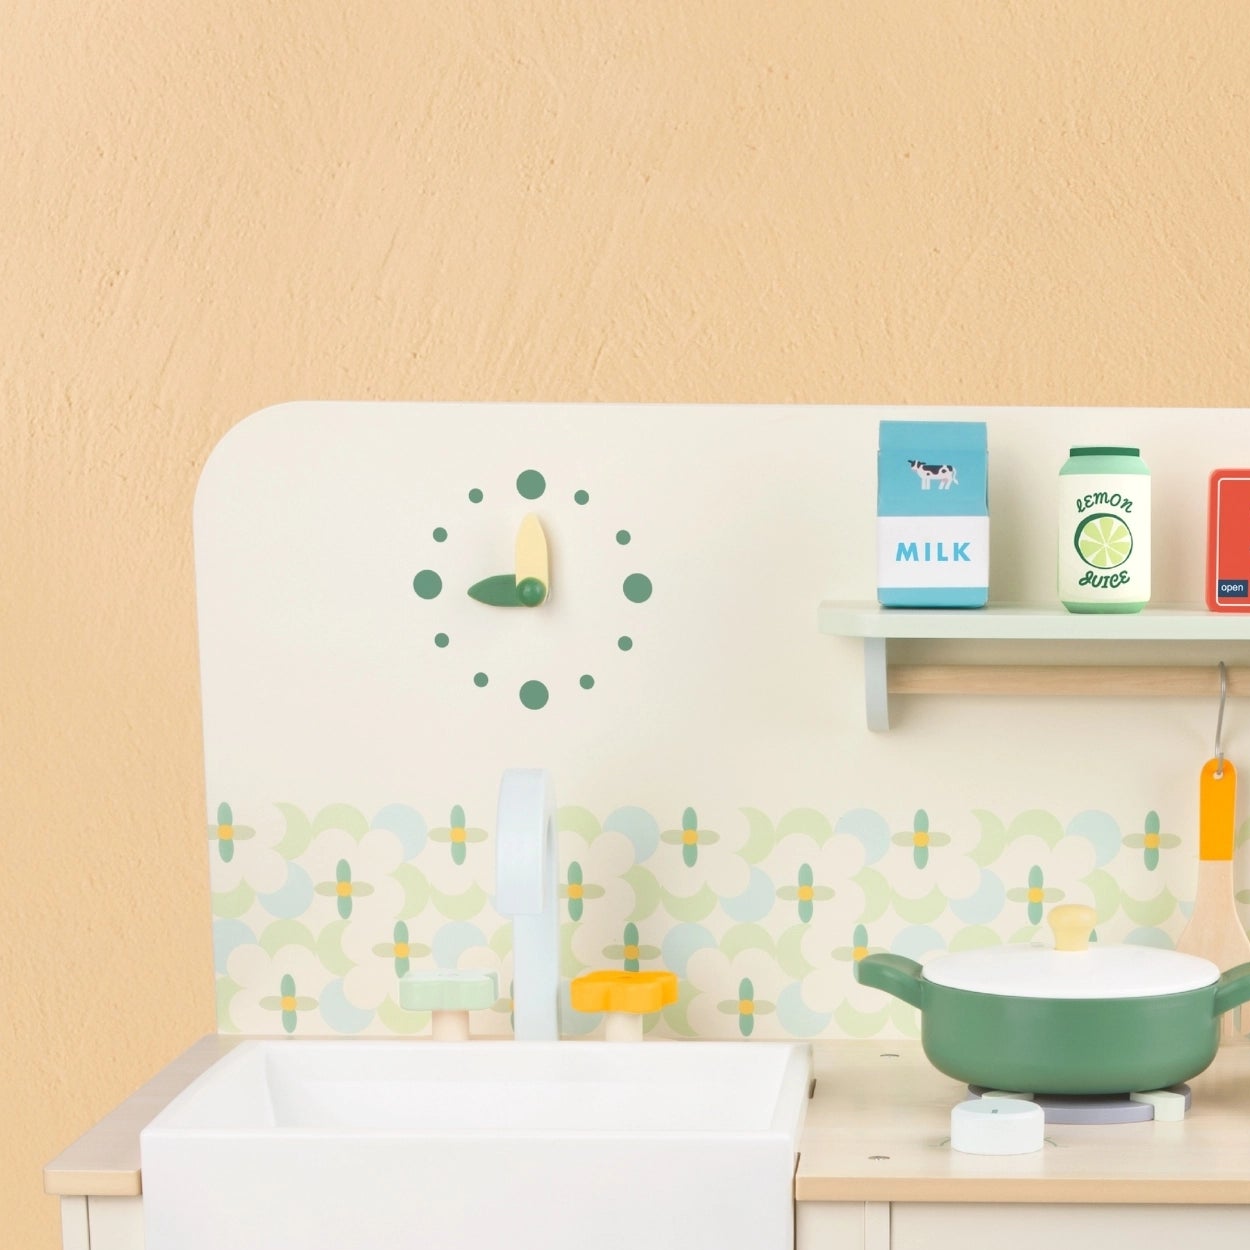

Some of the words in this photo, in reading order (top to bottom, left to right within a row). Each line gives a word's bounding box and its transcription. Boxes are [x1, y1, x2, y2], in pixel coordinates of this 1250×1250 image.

[895, 542, 971, 562] MILK
[1078, 570, 1131, 589] JUICE
[1221, 583, 1244, 593] open
